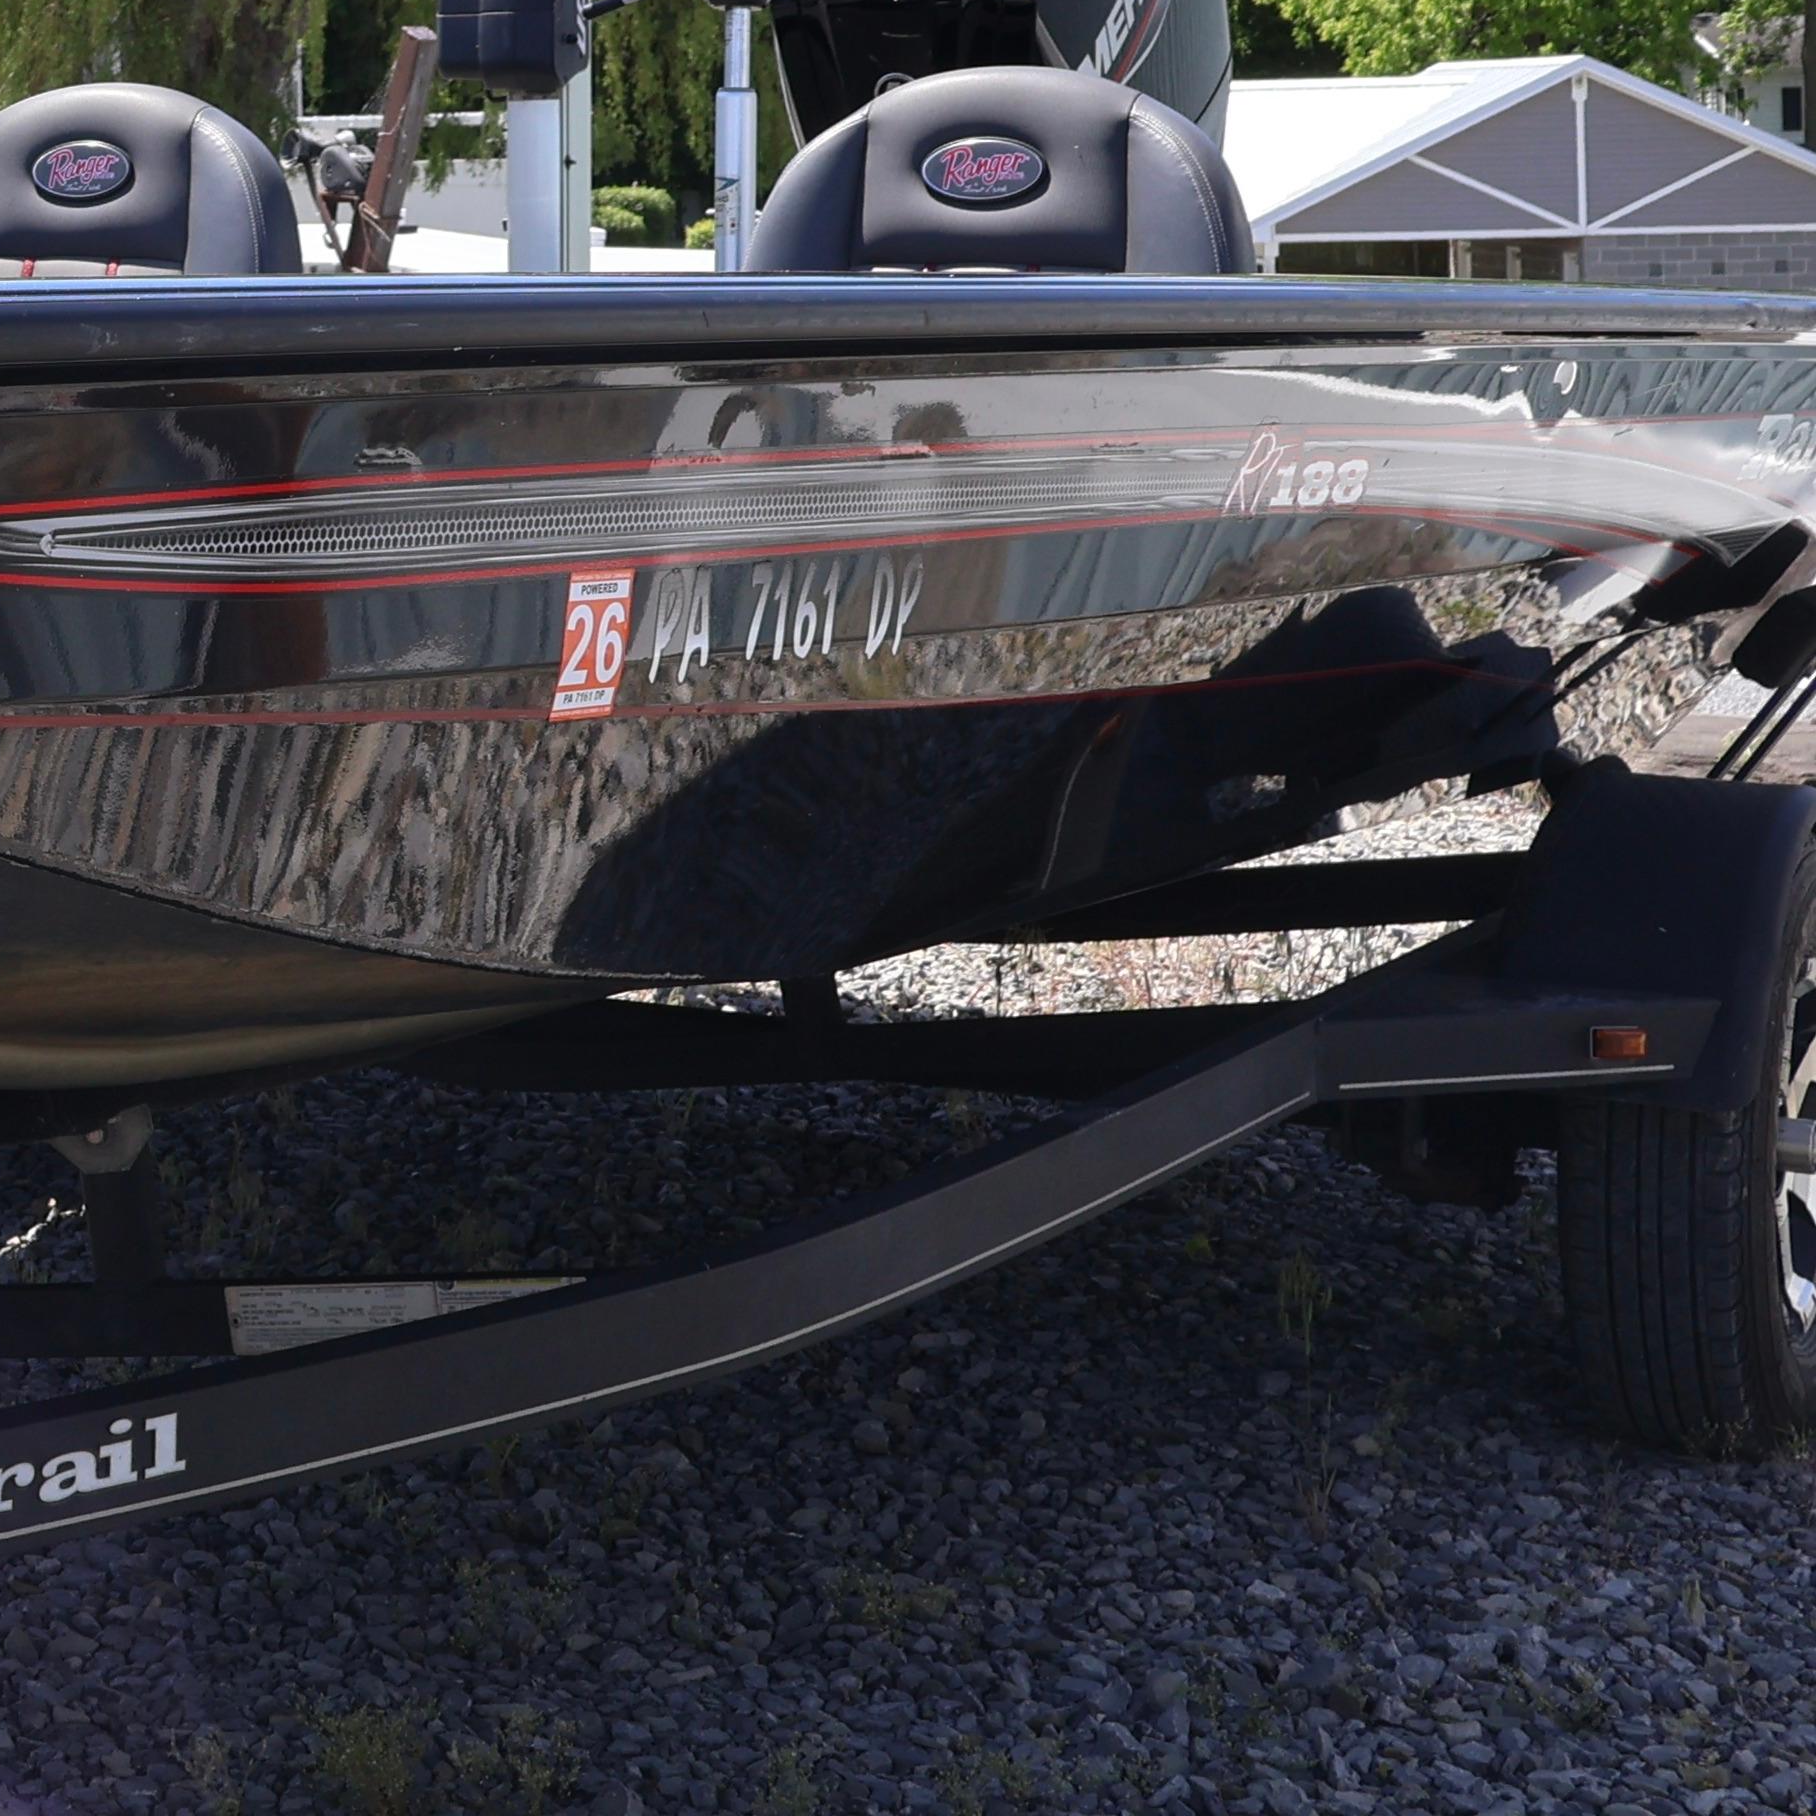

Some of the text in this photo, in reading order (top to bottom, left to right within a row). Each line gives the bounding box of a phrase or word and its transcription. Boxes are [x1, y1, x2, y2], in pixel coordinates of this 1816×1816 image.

[47, 148, 120, 189] Ranger
[941, 146, 1028, 190] Ranger
[580, 582, 618, 596] POWERED
[648, 553, 925, 684] PA 7161 DP
[558, 601, 626, 687] 26
[562, 689, 606, 704] PA 7161 DP
